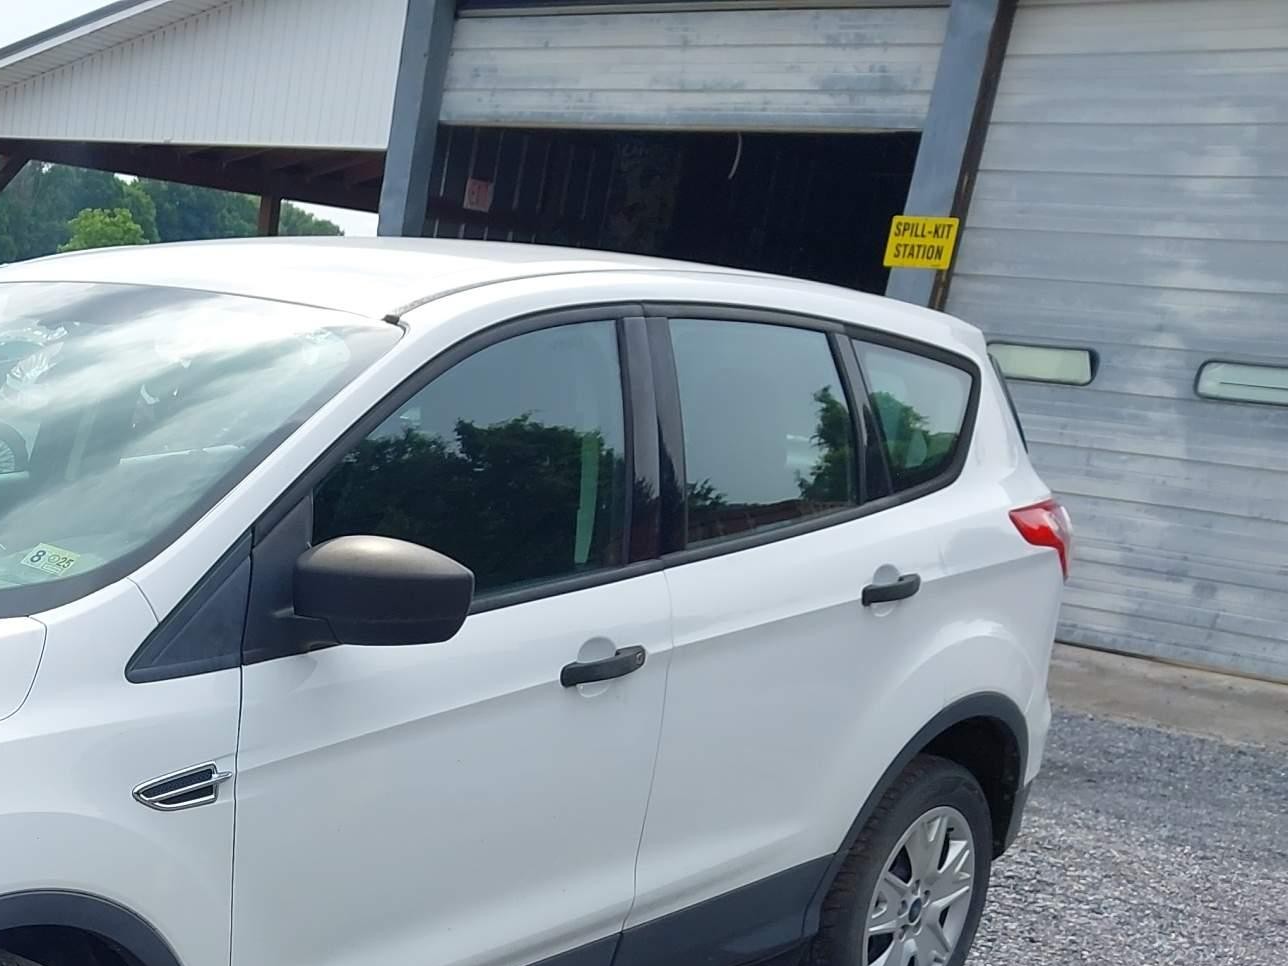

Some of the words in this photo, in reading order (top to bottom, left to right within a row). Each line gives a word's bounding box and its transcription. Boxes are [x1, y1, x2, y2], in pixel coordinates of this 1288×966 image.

[894, 221, 954, 240] SPILL-KIT
[893, 243, 944, 261] STATION
[30, 550, 47, 563] 8
[56, 556, 75, 569] 25
